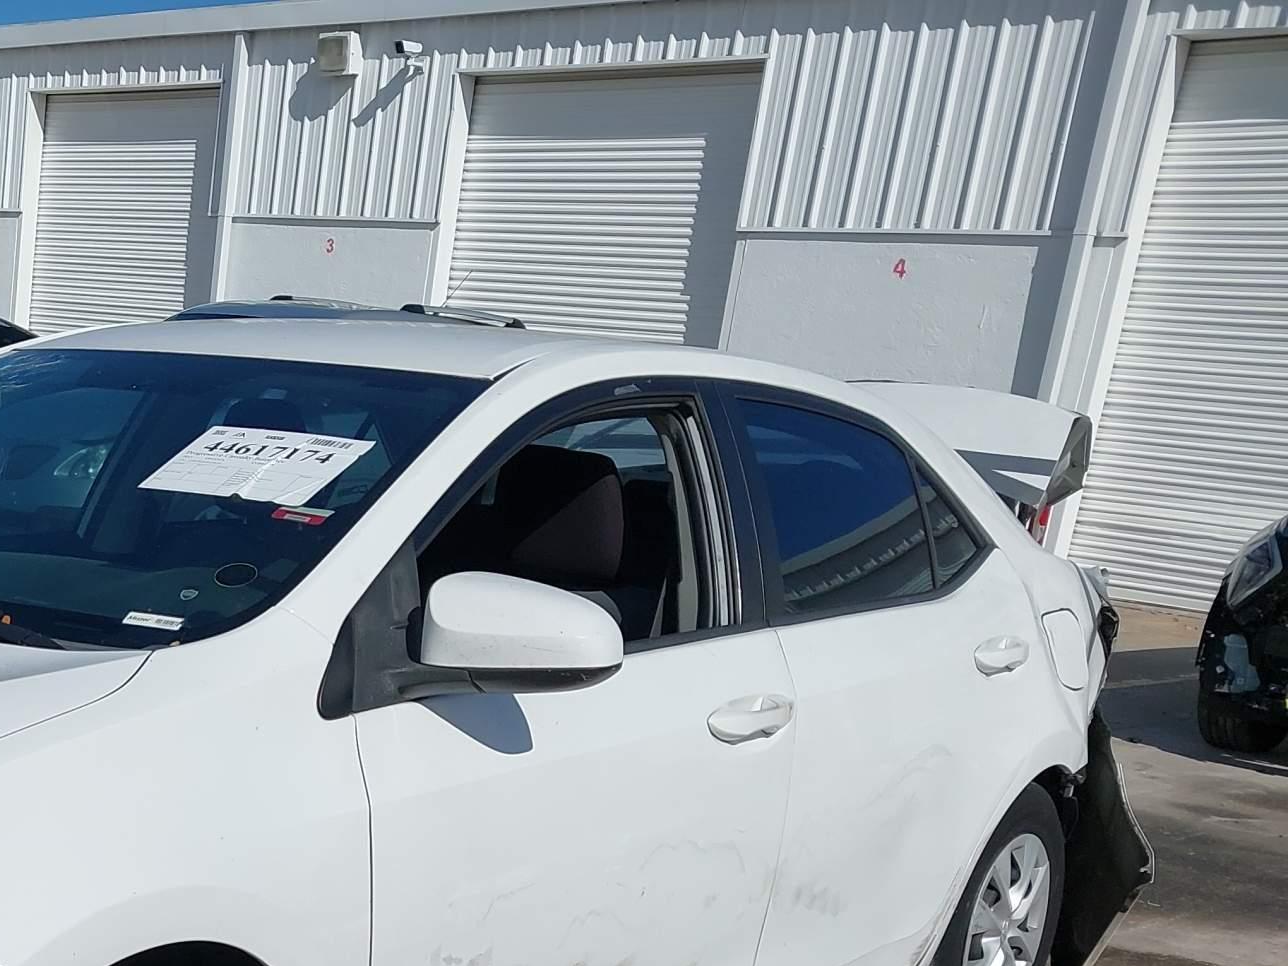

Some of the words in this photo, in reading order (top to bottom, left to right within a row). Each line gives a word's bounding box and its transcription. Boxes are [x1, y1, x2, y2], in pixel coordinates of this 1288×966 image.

[326, 238, 334, 253] 3
[893, 258, 906, 279] 4
[203, 441, 336, 464] 44617174
